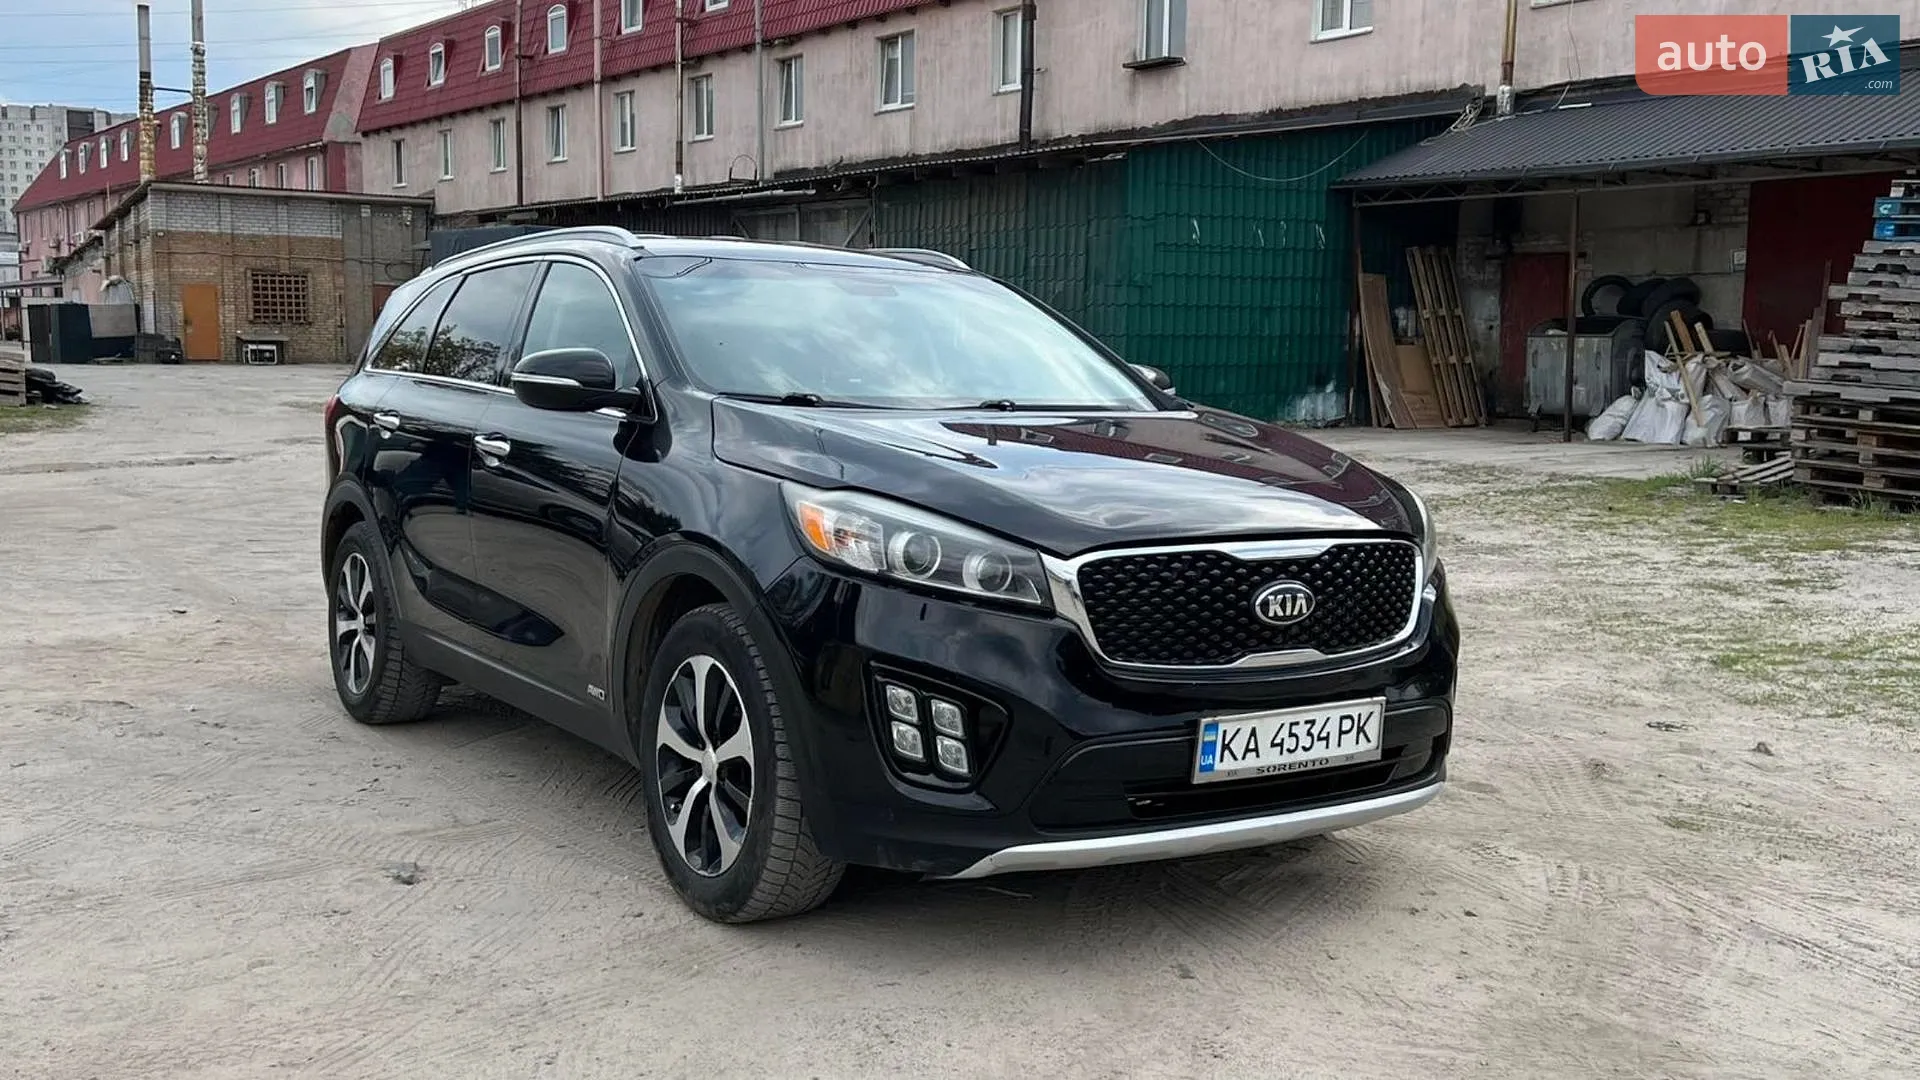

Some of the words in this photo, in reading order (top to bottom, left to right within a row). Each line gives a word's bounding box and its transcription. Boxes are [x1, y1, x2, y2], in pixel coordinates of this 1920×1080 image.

[1267, 594, 1307, 617] KIA
[1219, 727, 1261, 763] KA
[1270, 716, 1331, 756] 4534
[1337, 711, 1374, 748] PK
[1200, 755, 1214, 766] UA
[1255, 758, 1329, 774] SORENTO
